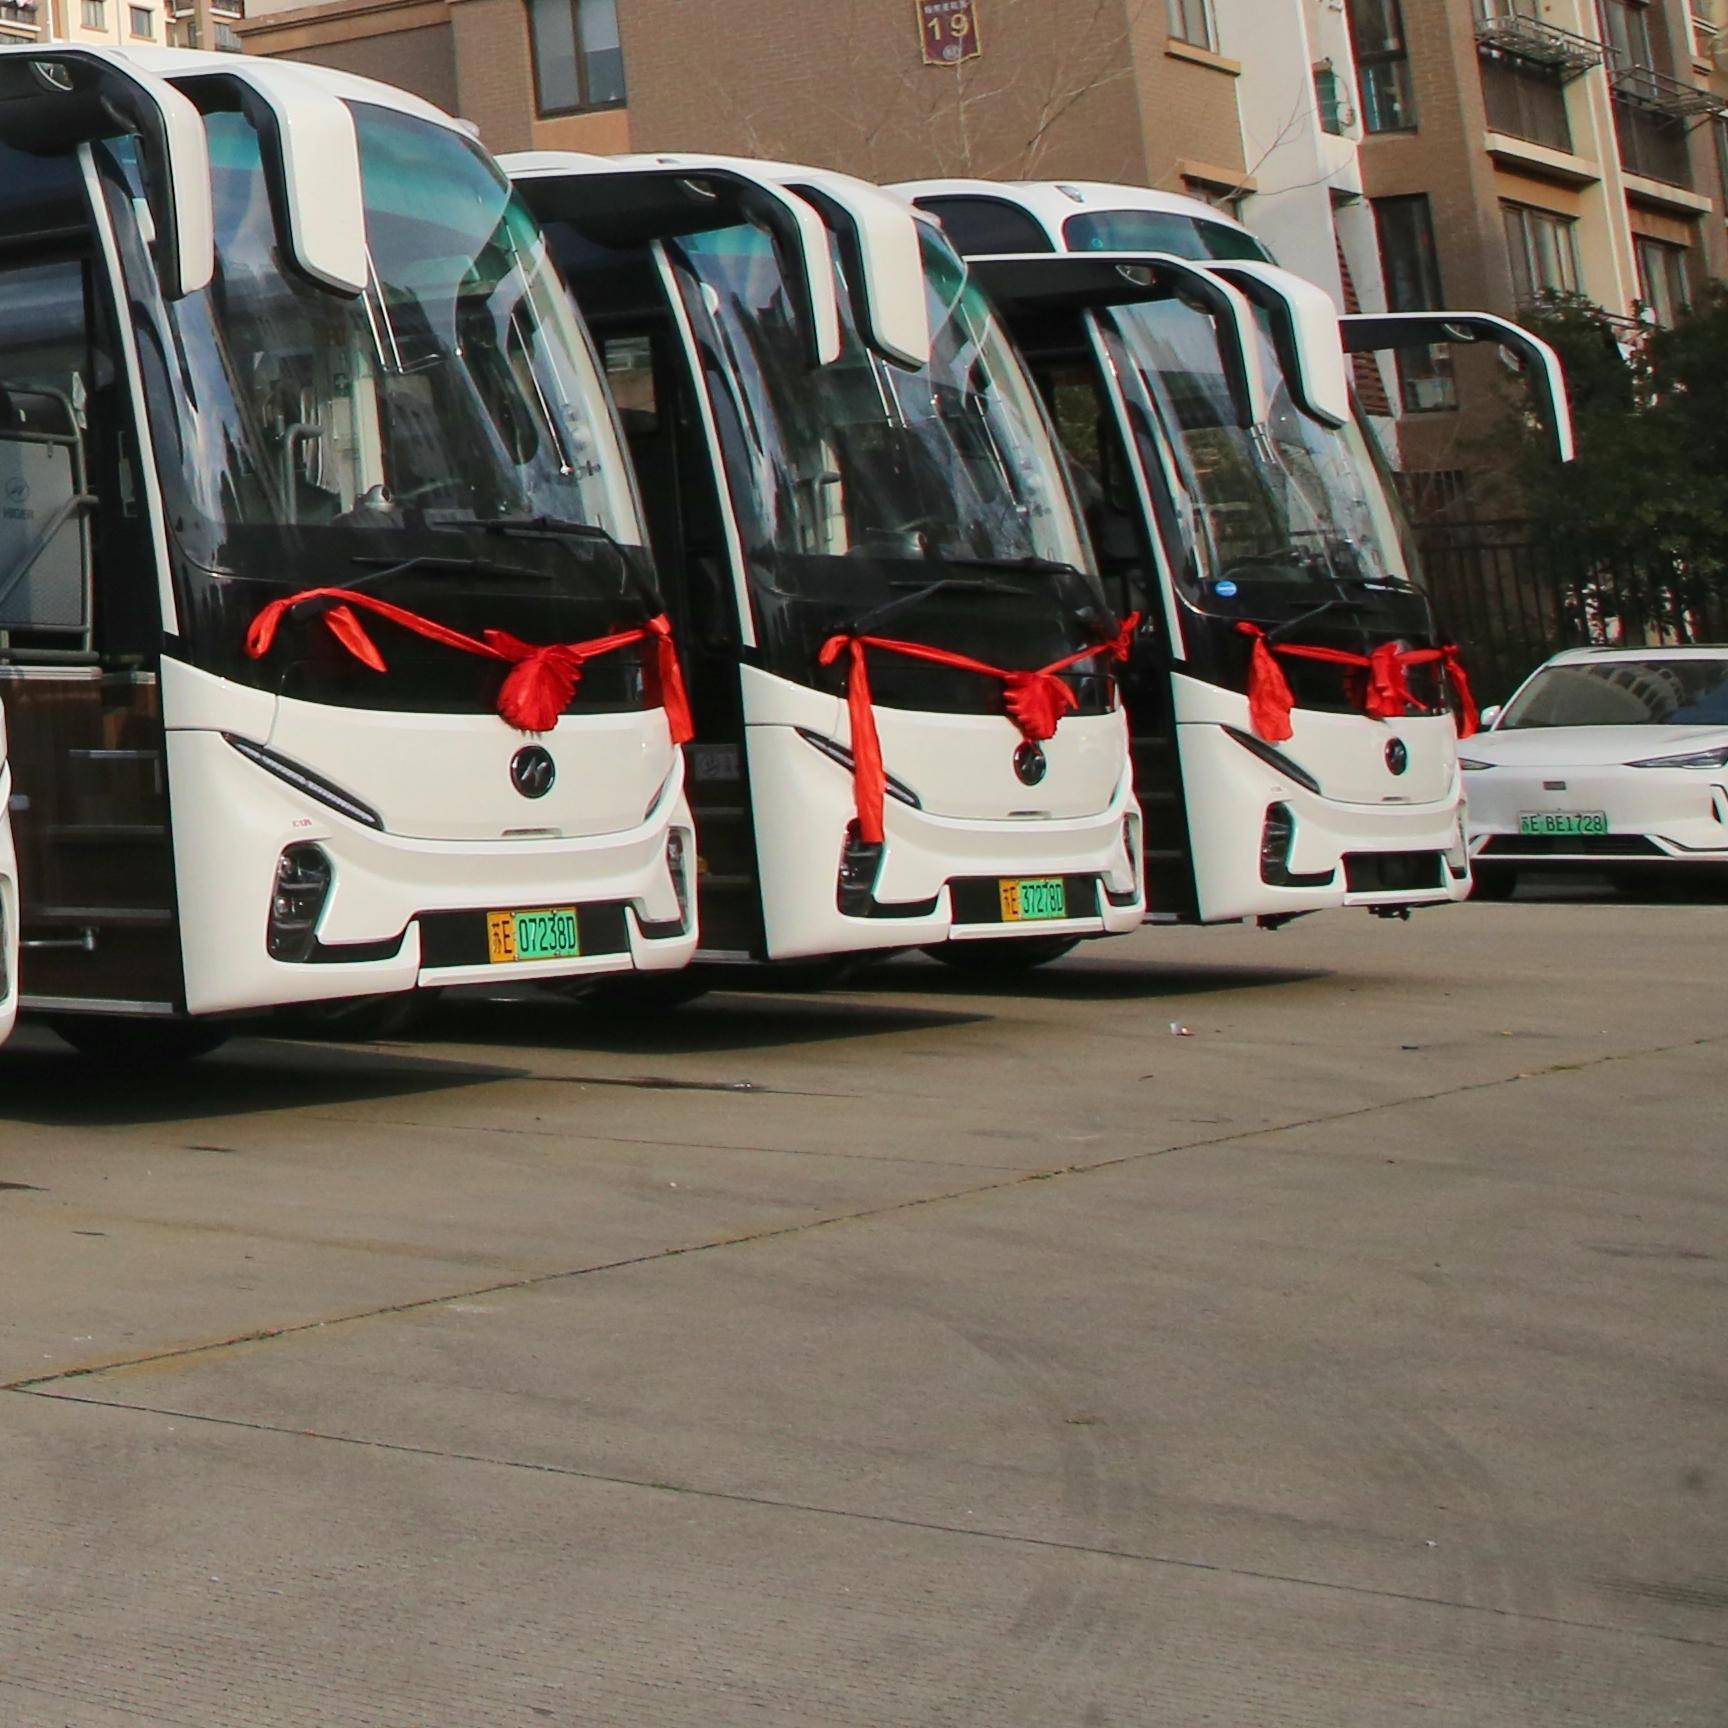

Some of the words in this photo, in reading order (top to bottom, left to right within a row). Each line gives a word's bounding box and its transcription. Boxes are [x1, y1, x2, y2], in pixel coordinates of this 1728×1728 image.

[928, 14, 969, 40] 19
[1545, 815, 1604, 832] BE1728
[519, 916, 576, 953] 07238D
